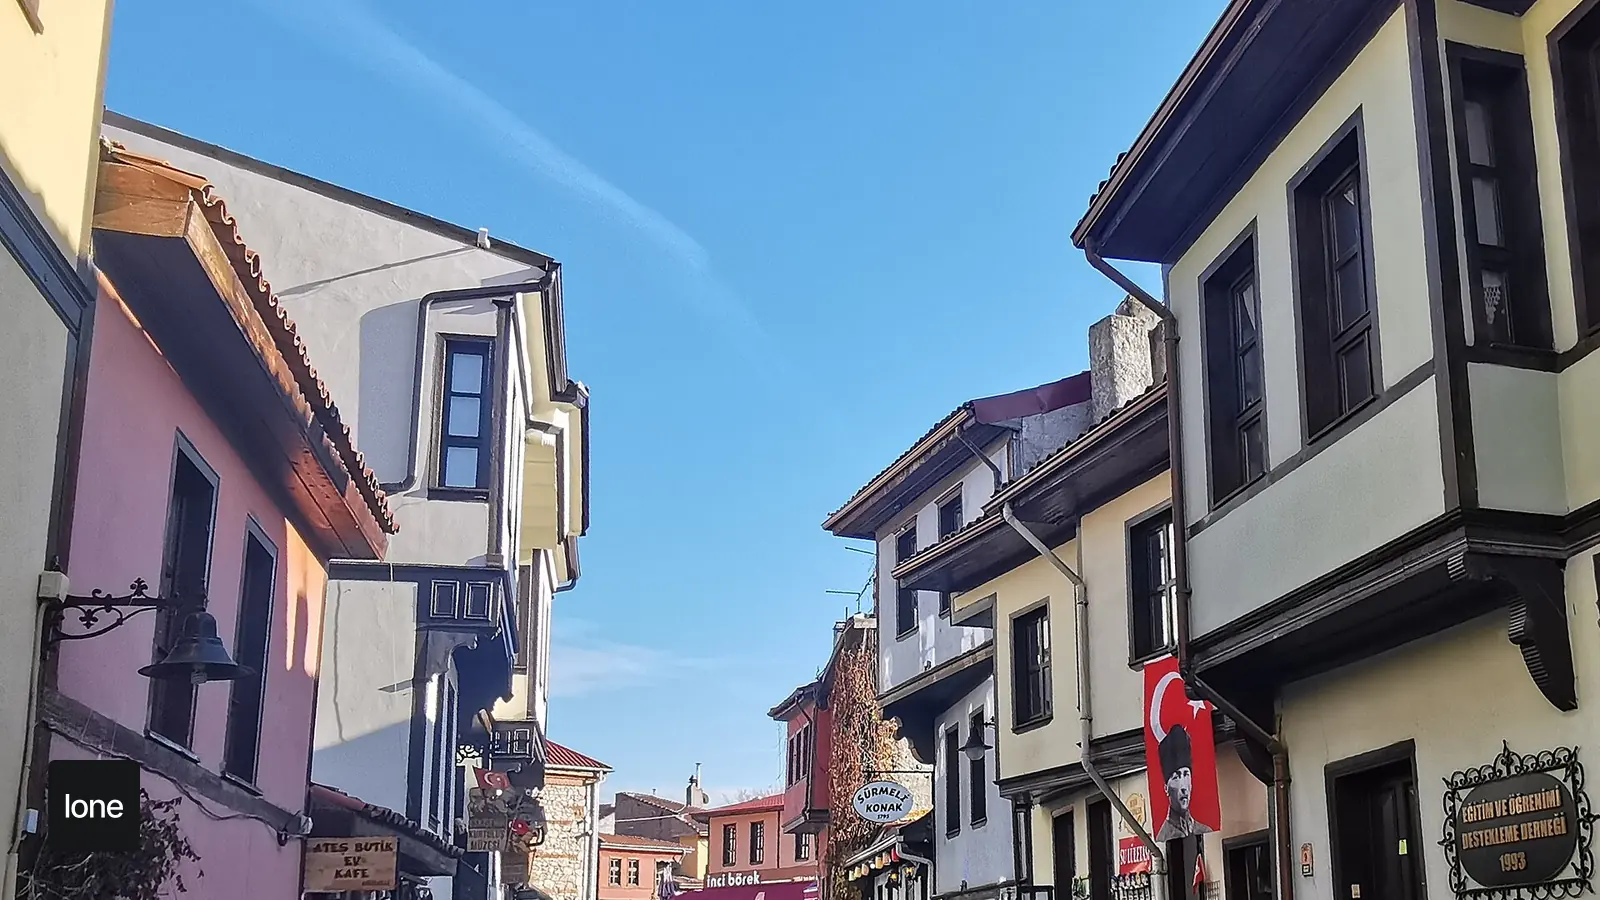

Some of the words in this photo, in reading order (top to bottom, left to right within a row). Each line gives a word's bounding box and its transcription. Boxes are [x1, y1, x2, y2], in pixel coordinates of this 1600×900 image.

[857, 786, 910, 804] SÜRMELİ
[866, 803, 903, 813] KONAK
[1461, 799, 1495, 824] EĞİTİM
[1495, 798, 1508, 817] VE
[1508, 785, 1562, 815] ÖĞRENİMİ
[1461, 824, 1520, 850] DESTEKLEME
[1520, 812, 1567, 840] DERNEĞİ
[312, 842, 349, 855] ATEŞ
[354, 840, 393, 852] BUTİK
[344, 856, 362, 866] EV
[1499, 851, 1527, 872] 1993
[334, 869, 370, 879] KAFE
[707, 874, 726, 888] inci
[727, 870, 761, 886] börek
